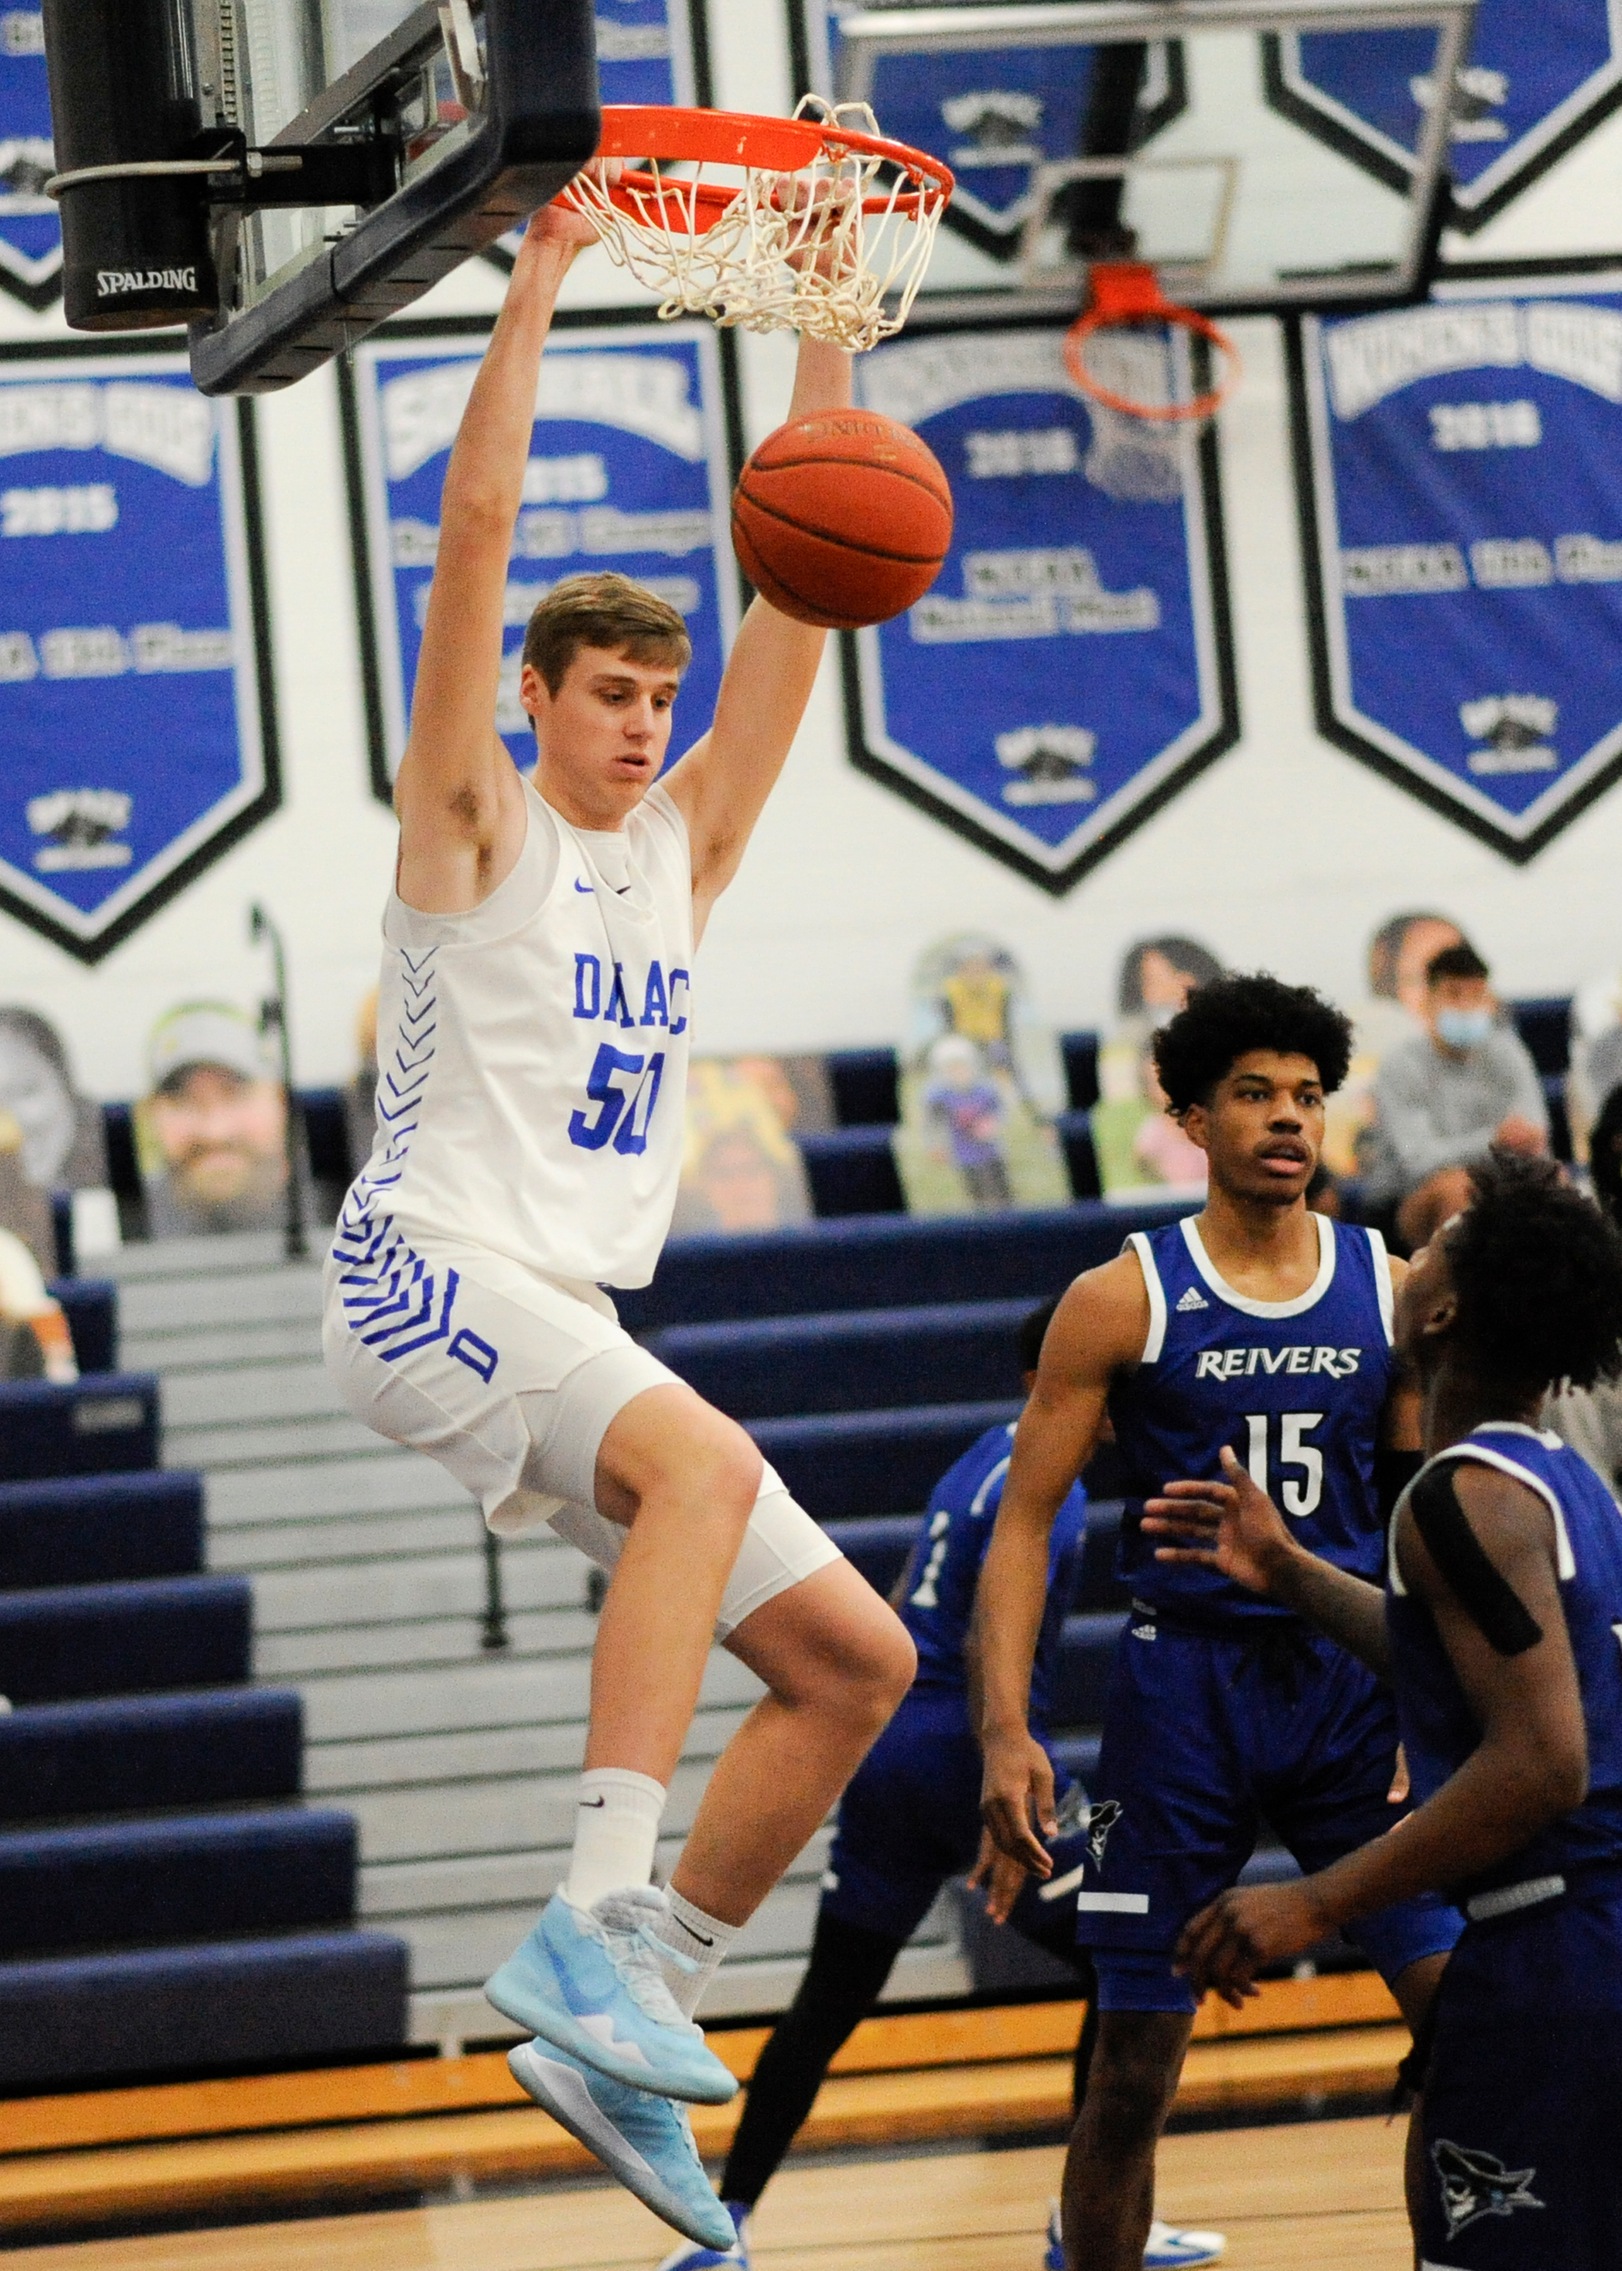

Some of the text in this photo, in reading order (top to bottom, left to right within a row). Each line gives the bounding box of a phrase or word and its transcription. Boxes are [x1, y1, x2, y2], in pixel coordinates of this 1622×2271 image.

[97, 266, 199, 297] SPALDING
[568, 1042, 665, 1157] 50
[446, 1327, 499, 1385] D
[1195, 1346, 1362, 1381] REIVERS
[1245, 1413, 1324, 1517] 15
